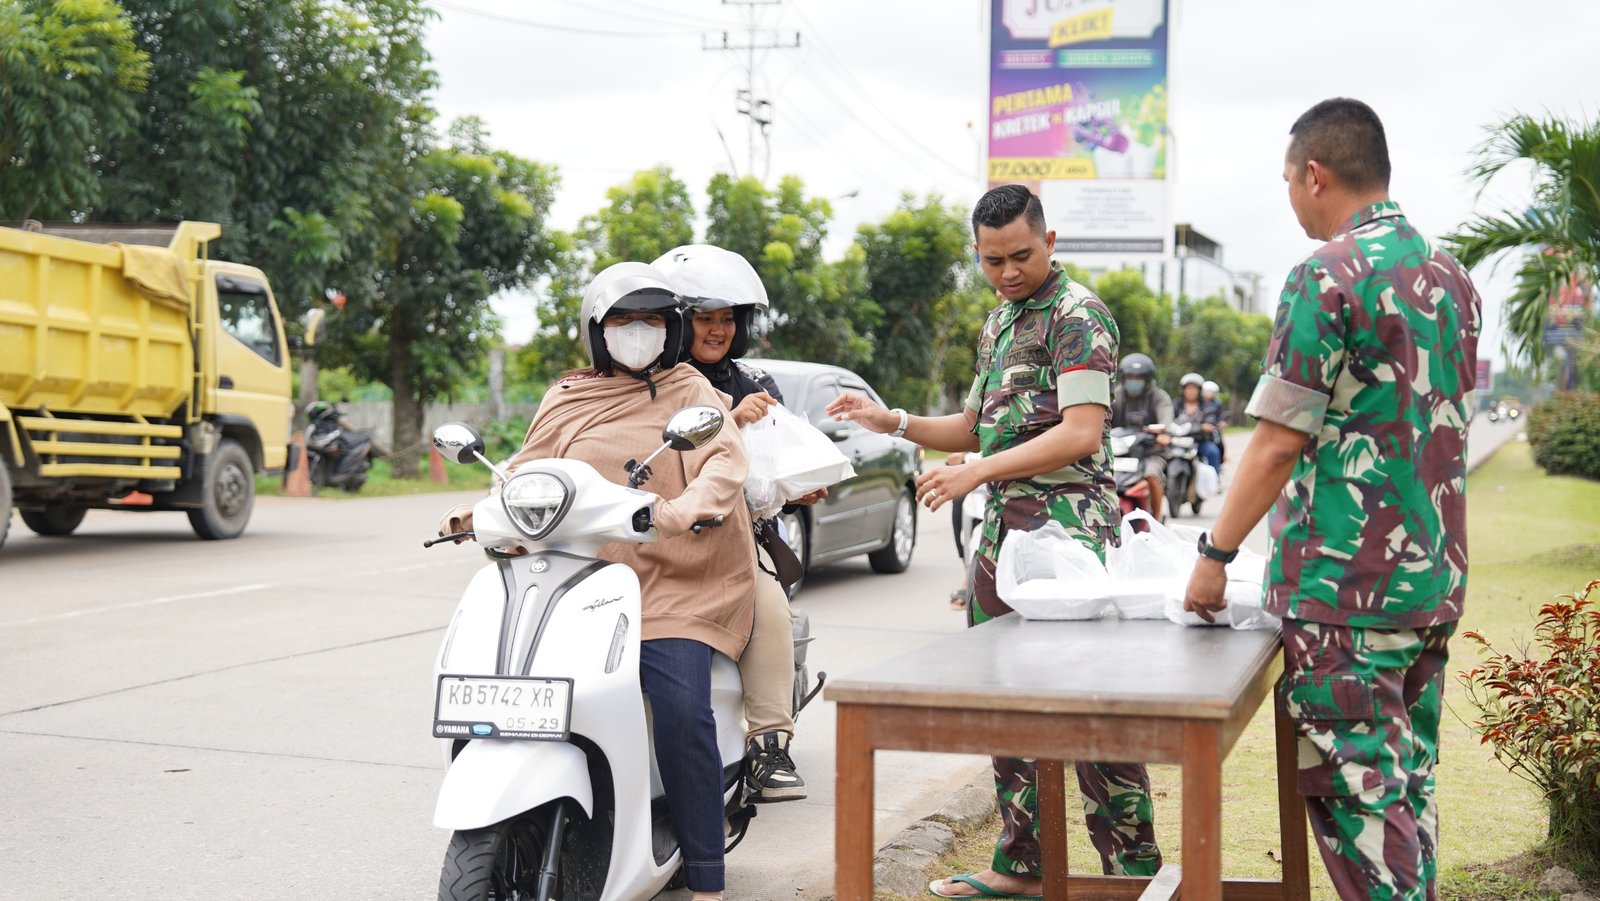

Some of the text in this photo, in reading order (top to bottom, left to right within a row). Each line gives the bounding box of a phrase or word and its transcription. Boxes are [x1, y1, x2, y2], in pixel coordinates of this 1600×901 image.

[992, 83, 1074, 115] PERTAMA
[992, 112, 1050, 140] KRETEK
[1063, 98, 1121, 125] KAPSUL
[448, 684, 554, 708] KB 5742 XR
[443, 725, 470, 734] YAMAHA
